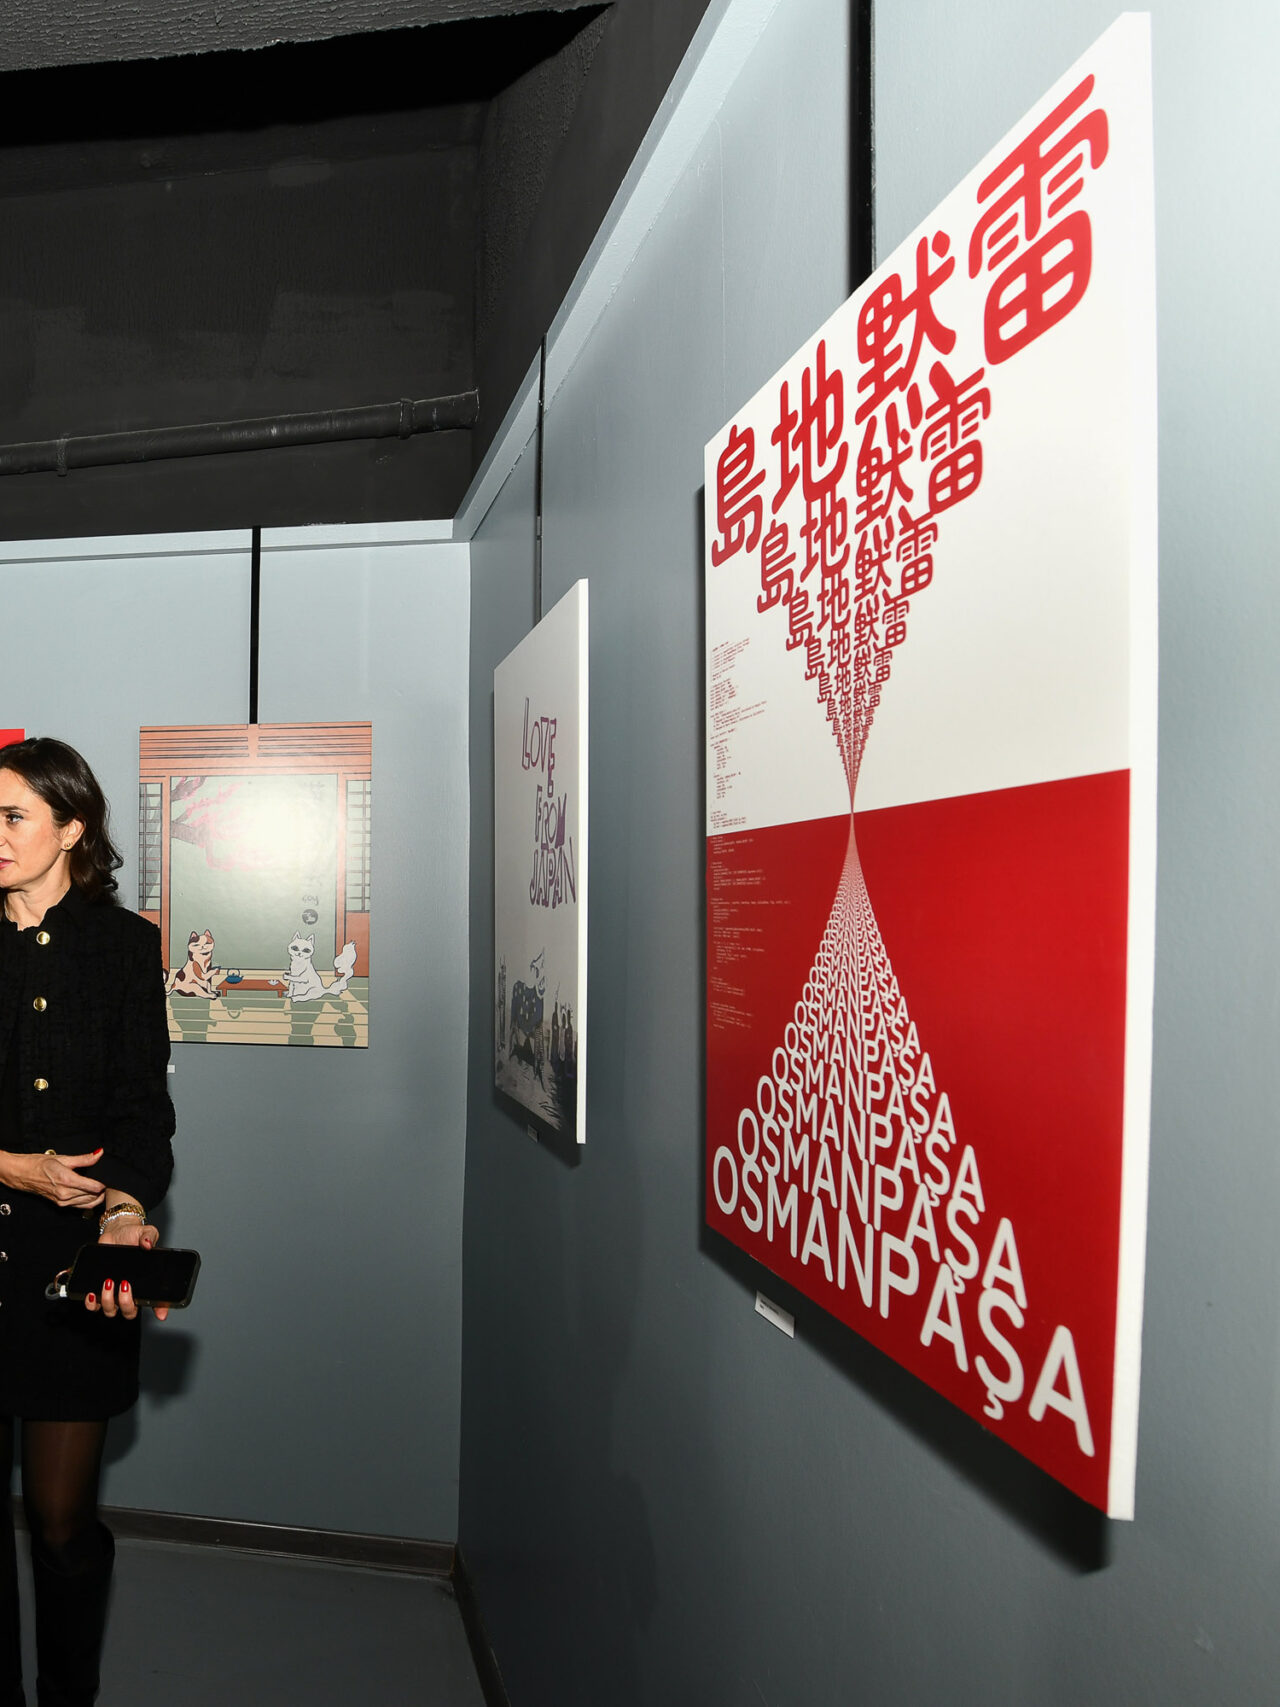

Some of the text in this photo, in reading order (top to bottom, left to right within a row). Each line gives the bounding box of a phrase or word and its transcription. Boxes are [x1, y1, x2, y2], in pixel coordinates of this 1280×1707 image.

[521, 697, 557, 798] LOVE
[534, 784, 567, 848] FROM
[529, 836, 577, 909] JAPAN
[784, 1022, 937, 1095] OSMANPAŞA
[794, 1001, 921, 1057] OSMANPAŞA
[756, 1075, 986, 1213] OSMANPAŞA
[772, 1047, 957, 1144] OSMANPAŞA
[737, 1108, 1028, 1310] OSMANPAŞA
[712, 1145, 1095, 1458] OSMANPAŞA
